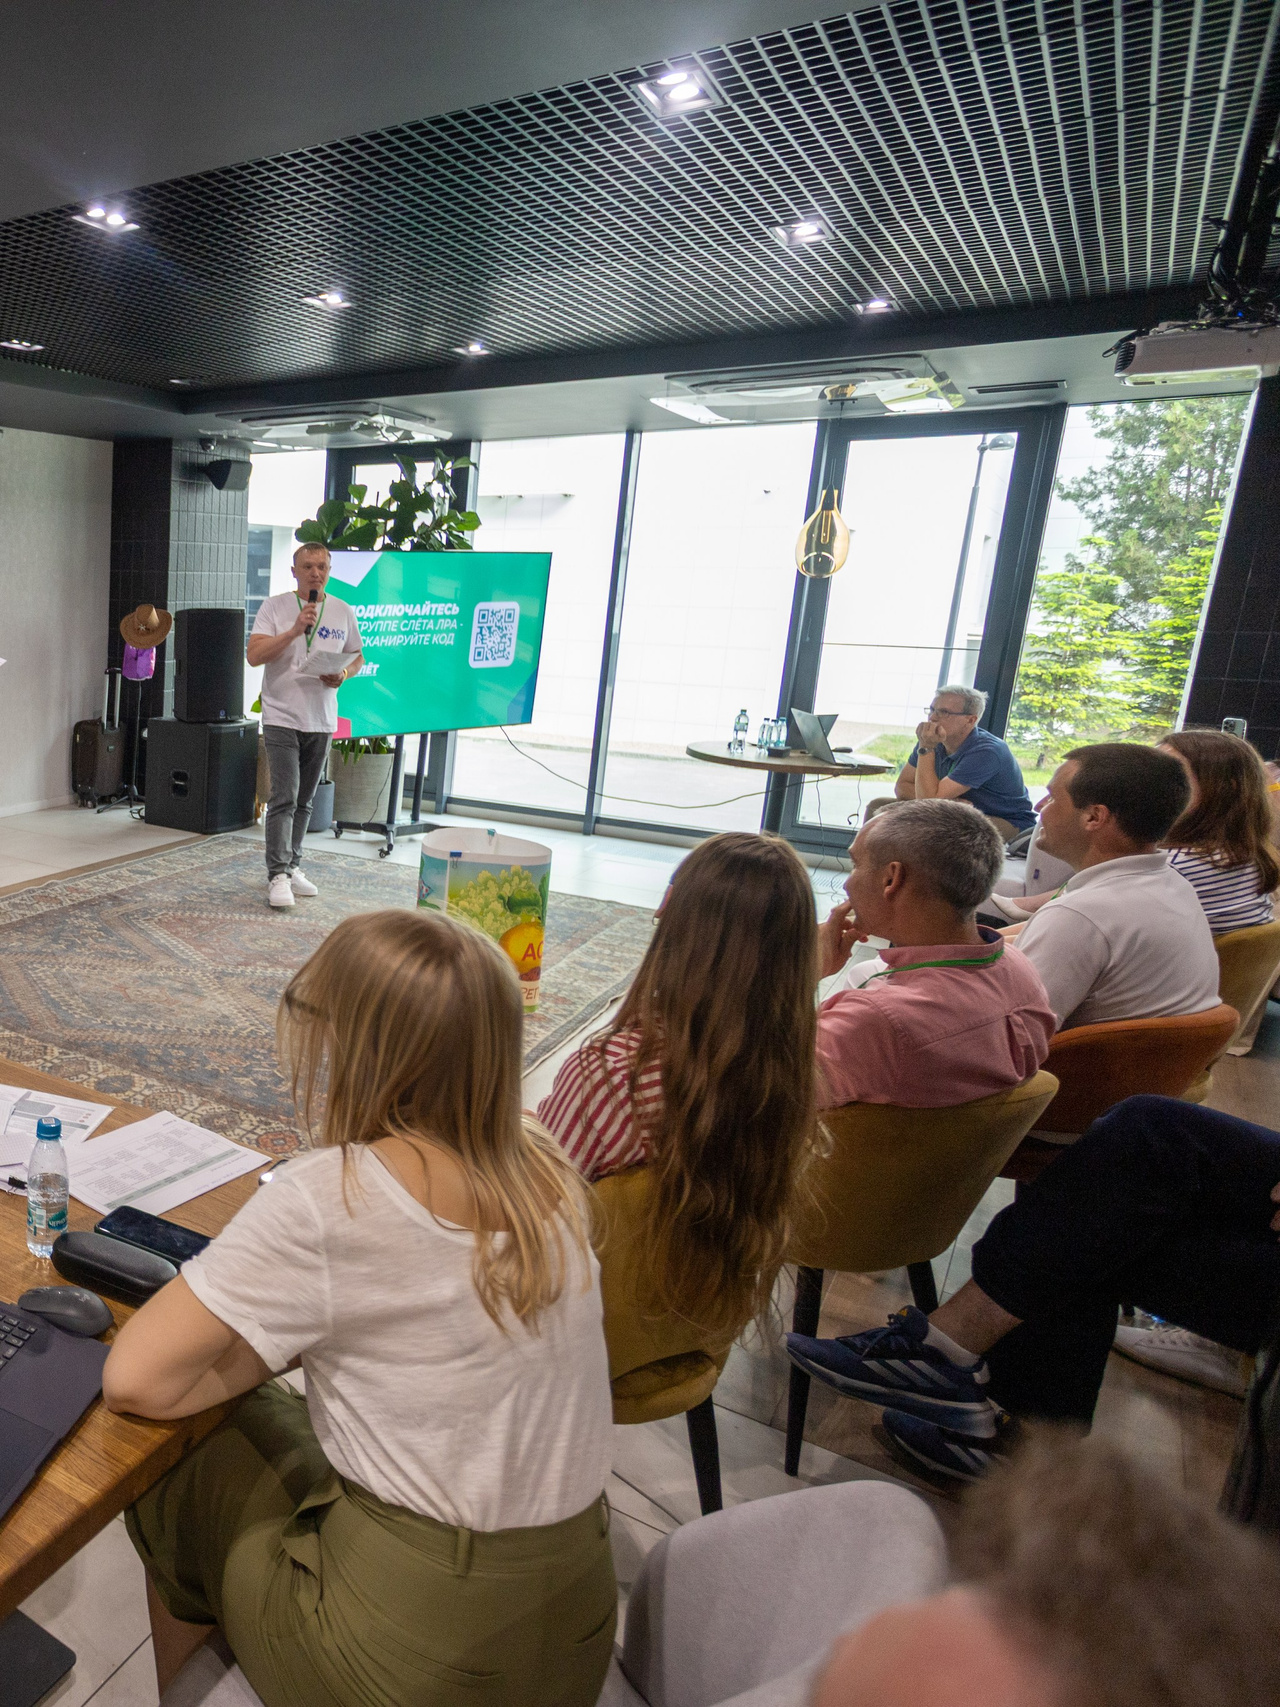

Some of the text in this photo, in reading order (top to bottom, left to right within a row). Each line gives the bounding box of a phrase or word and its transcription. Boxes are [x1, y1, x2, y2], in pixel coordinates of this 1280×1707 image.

[400, 618, 434, 632] СЛЁТА
[436, 619, 457, 631] ЛРА
[432, 633, 455, 645] КОД
[358, 661, 380, 675] ЛЁТ
